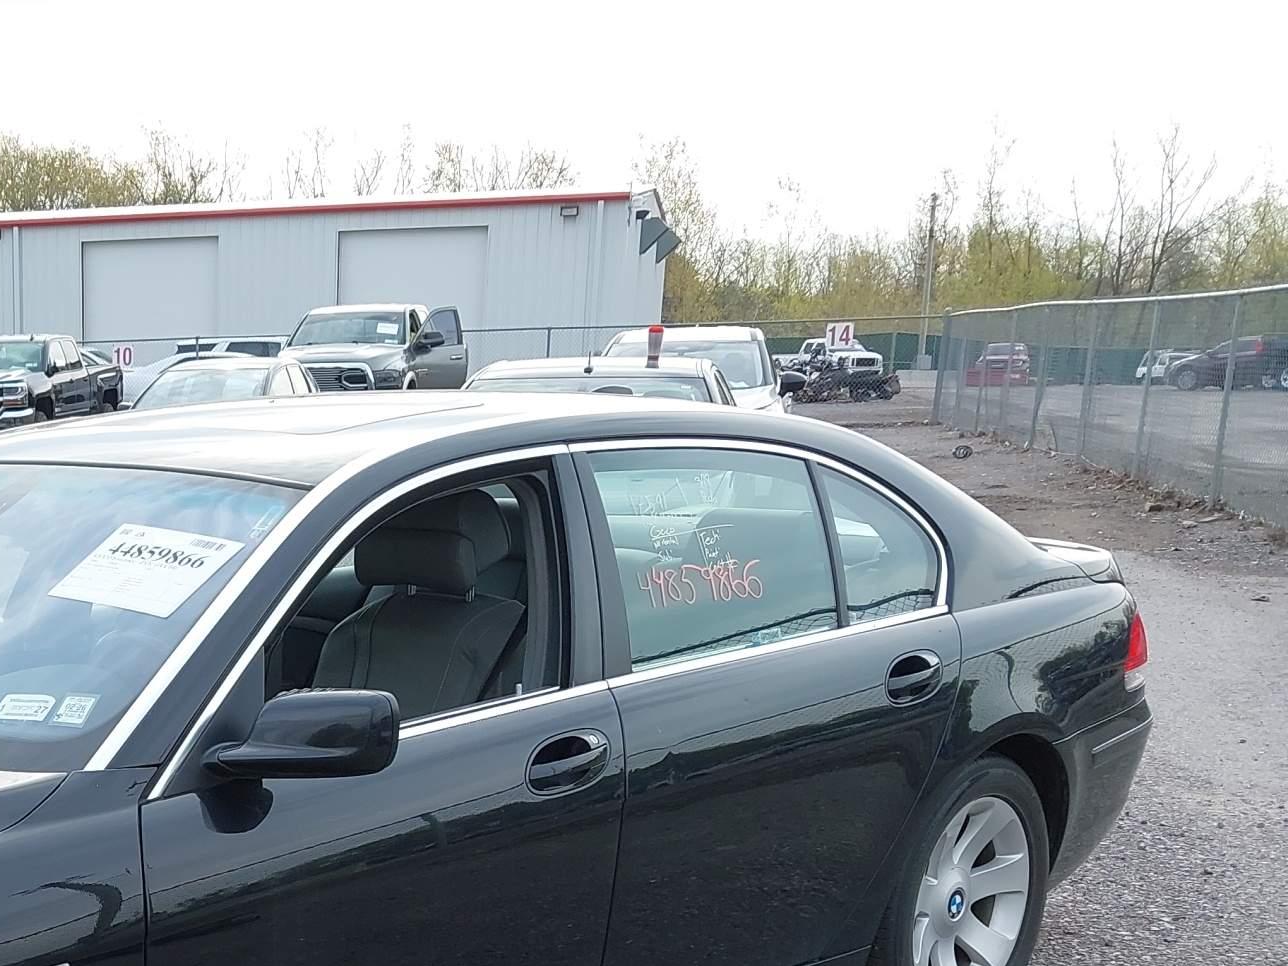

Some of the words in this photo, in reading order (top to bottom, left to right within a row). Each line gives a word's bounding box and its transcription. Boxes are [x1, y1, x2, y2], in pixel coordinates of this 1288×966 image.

[828, 325, 851, 346] 14
[114, 347, 132, 366] 10
[108, 542, 210, 569] 44859866
[637, 559, 762, 608] 44859866
